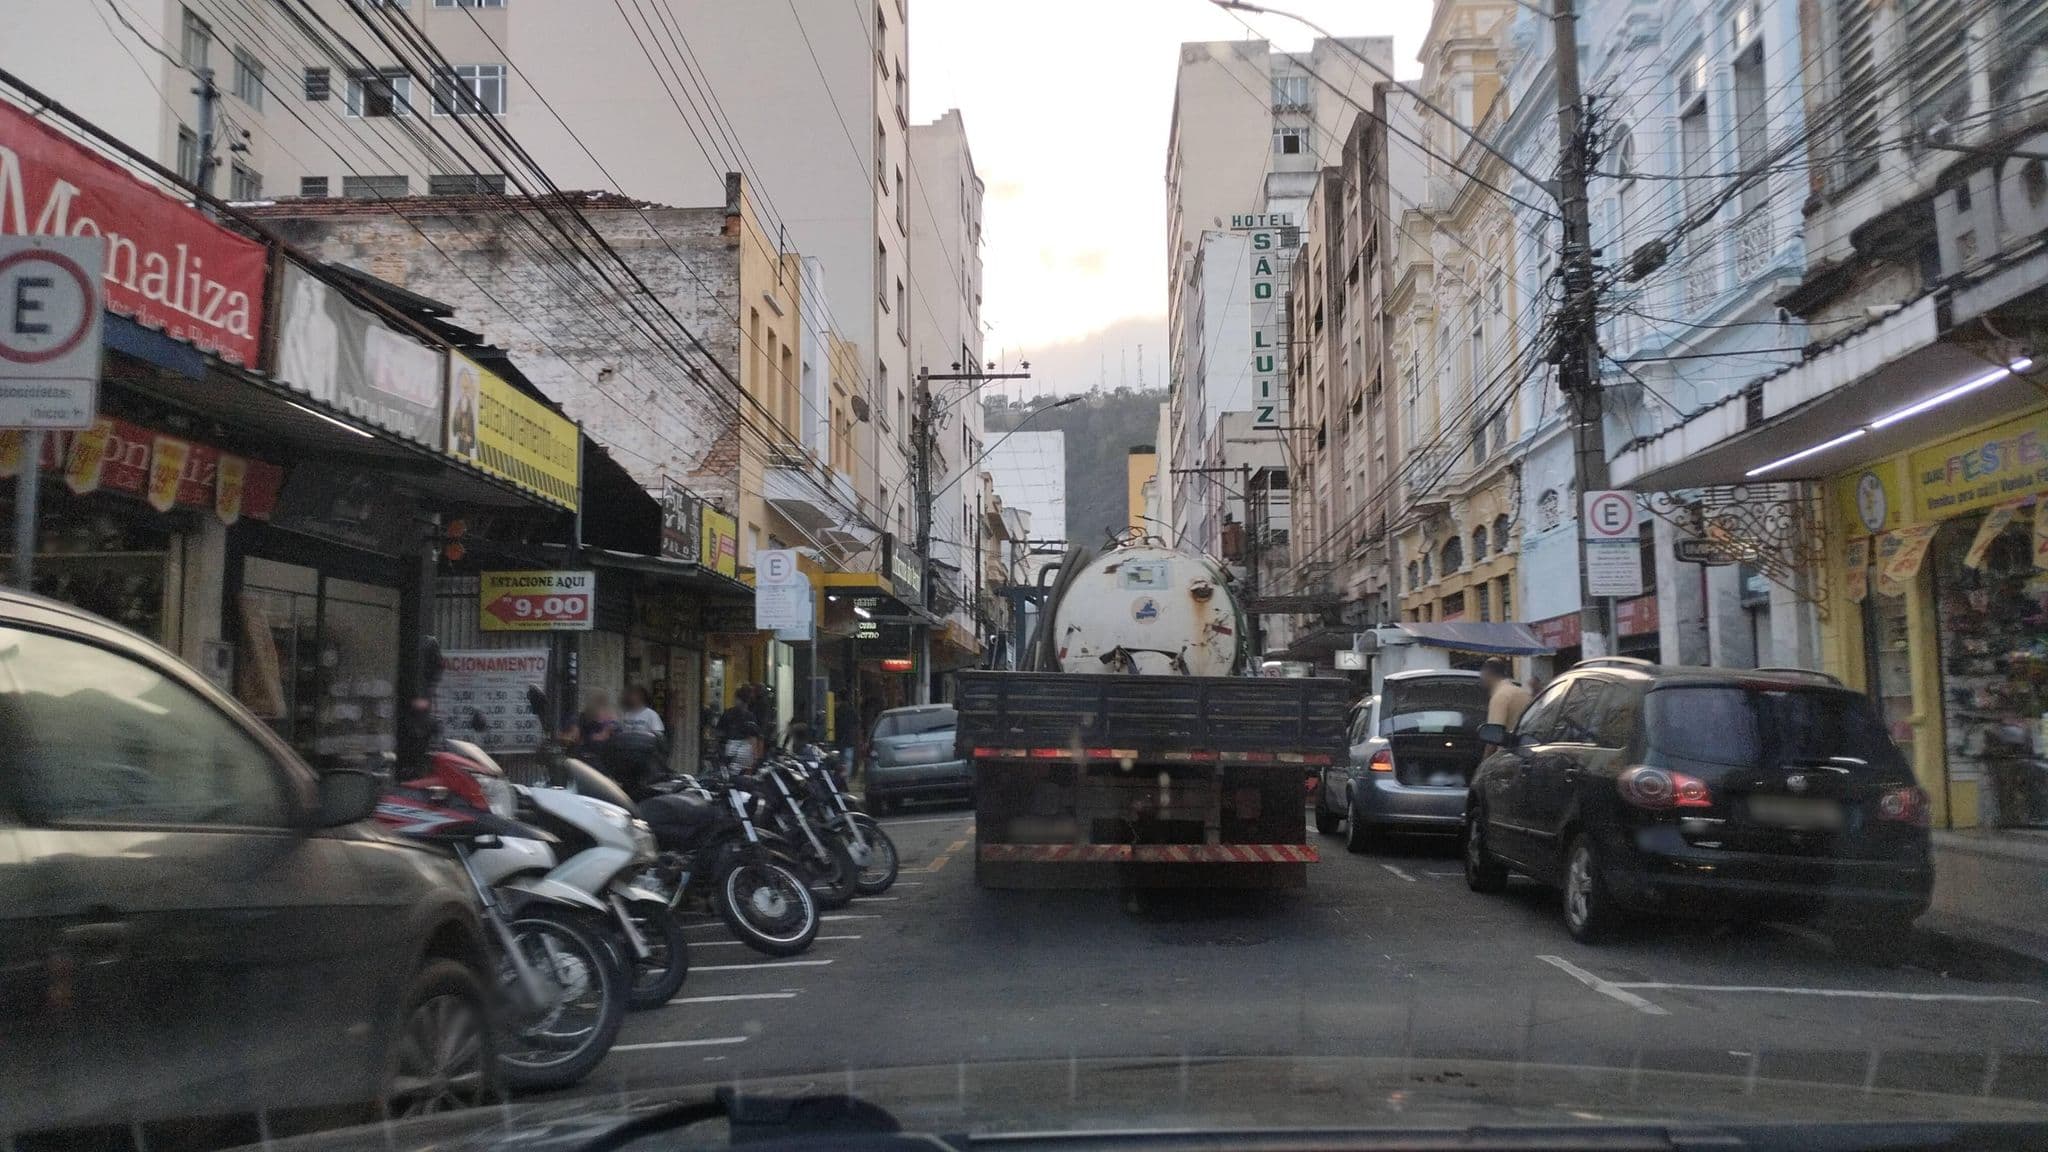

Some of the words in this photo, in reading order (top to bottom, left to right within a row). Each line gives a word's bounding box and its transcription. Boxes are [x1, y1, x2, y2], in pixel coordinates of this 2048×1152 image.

[1232, 214, 1292, 227] HOTEL
[15, 277, 54, 334] E
[1255, 331, 1274, 423] LUIZ
[1945, 430, 2048, 485] FESTE
[1604, 503, 1619, 526] E
[770, 559, 782, 577] E
[489, 576, 554, 588] ESTACIONE
[557, 576, 585, 589] AQUI
[515, 597, 584, 618] 9,00
[440, 656, 545, 671] ACIONAMENTO
